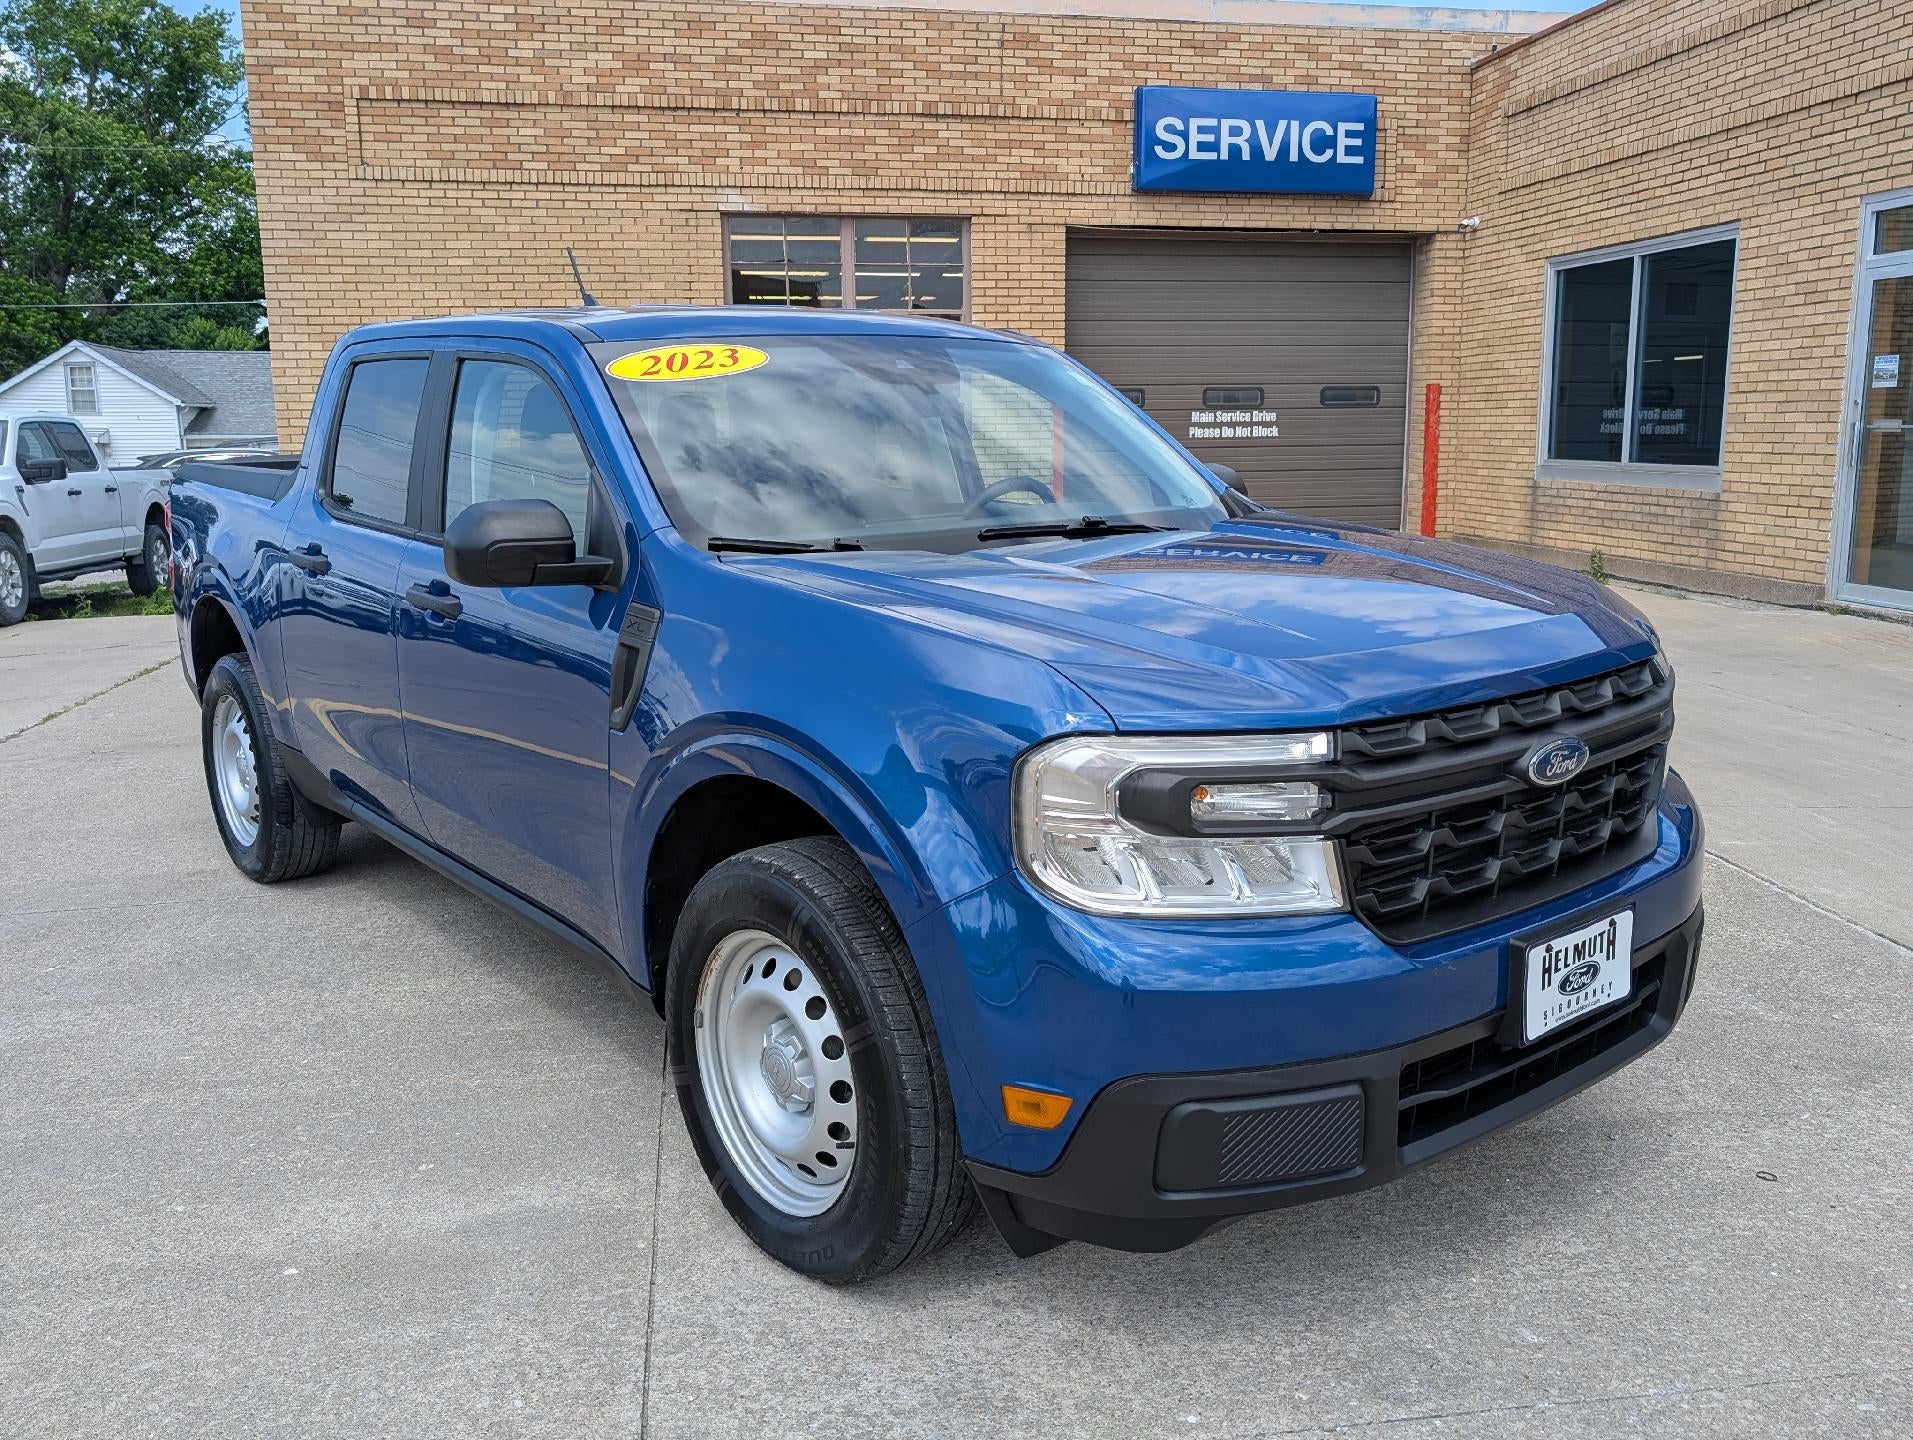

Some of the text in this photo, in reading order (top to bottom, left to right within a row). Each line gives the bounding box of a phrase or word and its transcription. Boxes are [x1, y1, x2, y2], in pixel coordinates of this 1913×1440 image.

[1153, 116, 1365, 165] SERVICE
[639, 347, 740, 377] 2023
[1191, 410, 1277, 423] Main Service Drive
[1188, 425, 1279, 439] Please Do Not Block
[1546, 748, 1580, 777] Ford
[1541, 924, 1617, 992] HELMUTH
[1565, 965, 1595, 992] Ford
[1543, 981, 1613, 1021] SIGOURNEY
